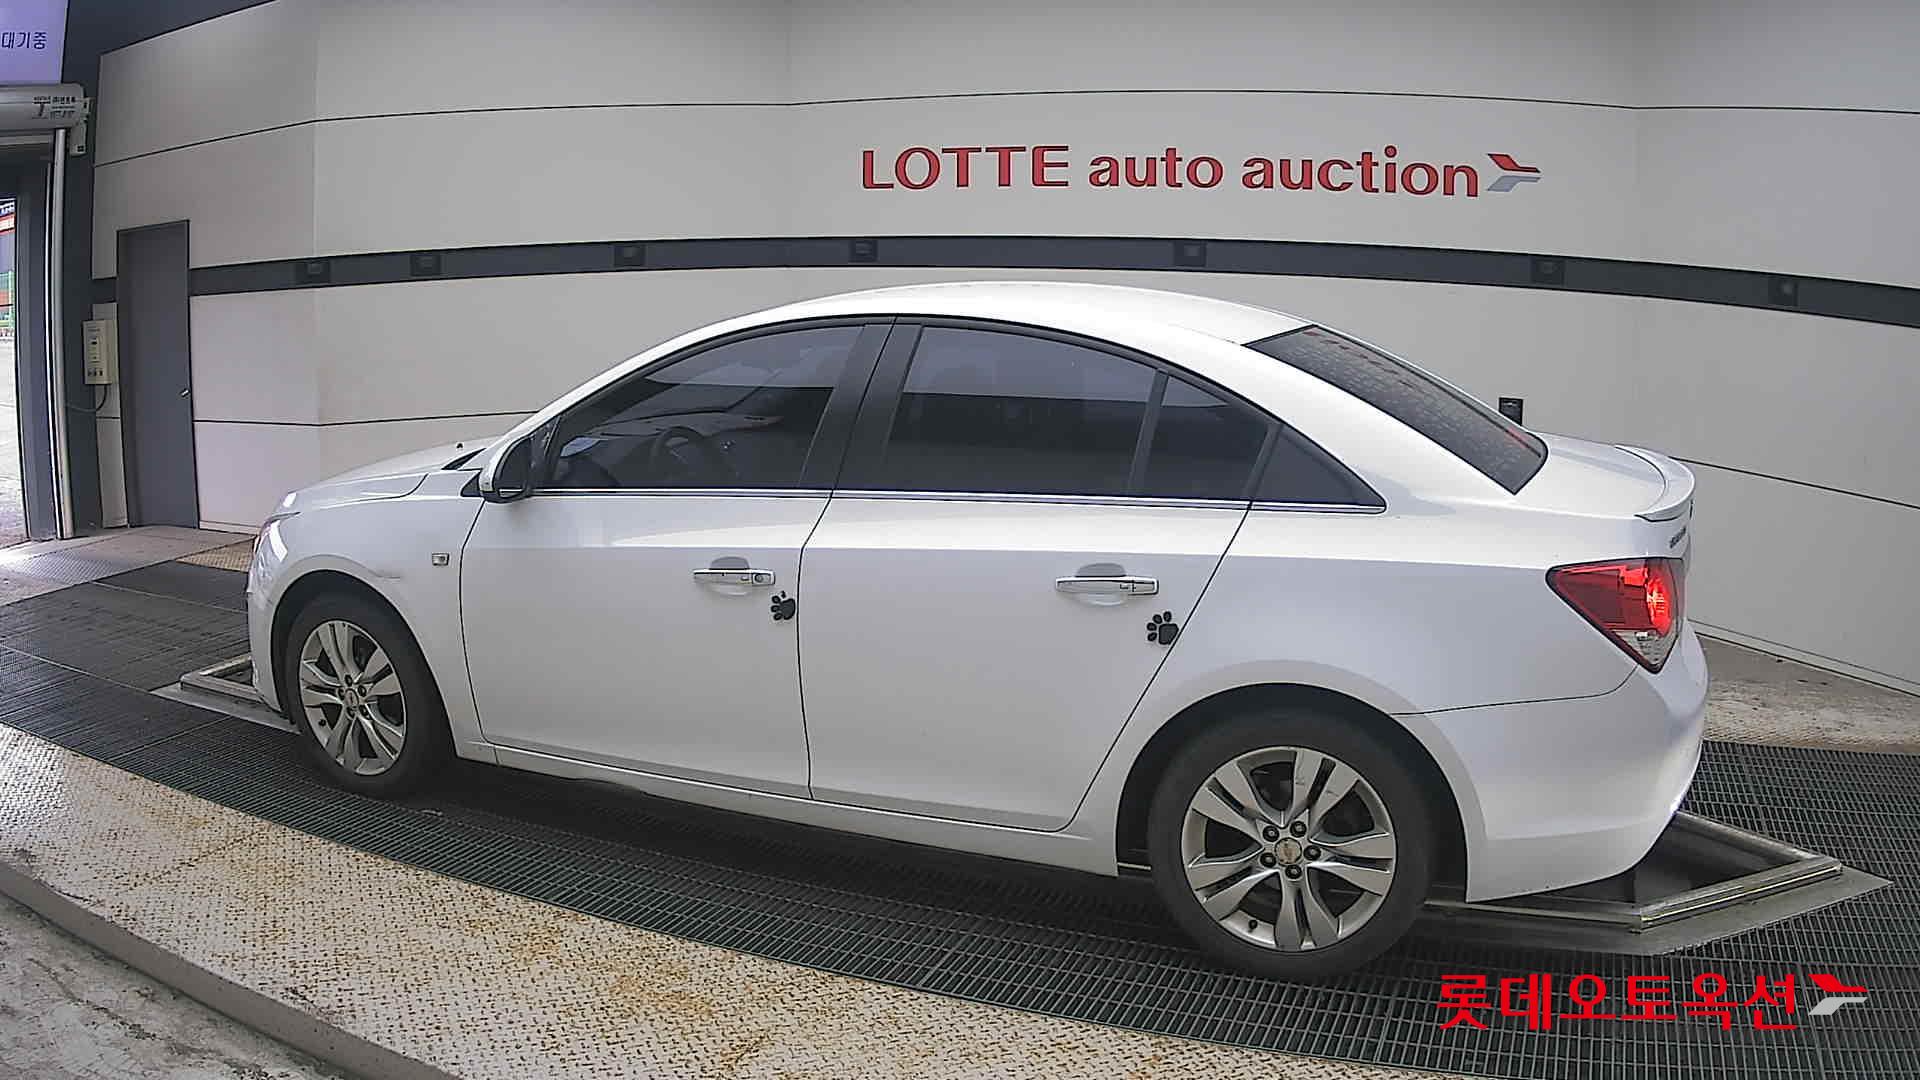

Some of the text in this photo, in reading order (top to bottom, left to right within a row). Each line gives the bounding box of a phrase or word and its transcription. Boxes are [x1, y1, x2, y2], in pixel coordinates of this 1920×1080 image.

[1, 31, 47, 50] 대기중
[863, 145, 1479, 198] LOTTE auto auction
